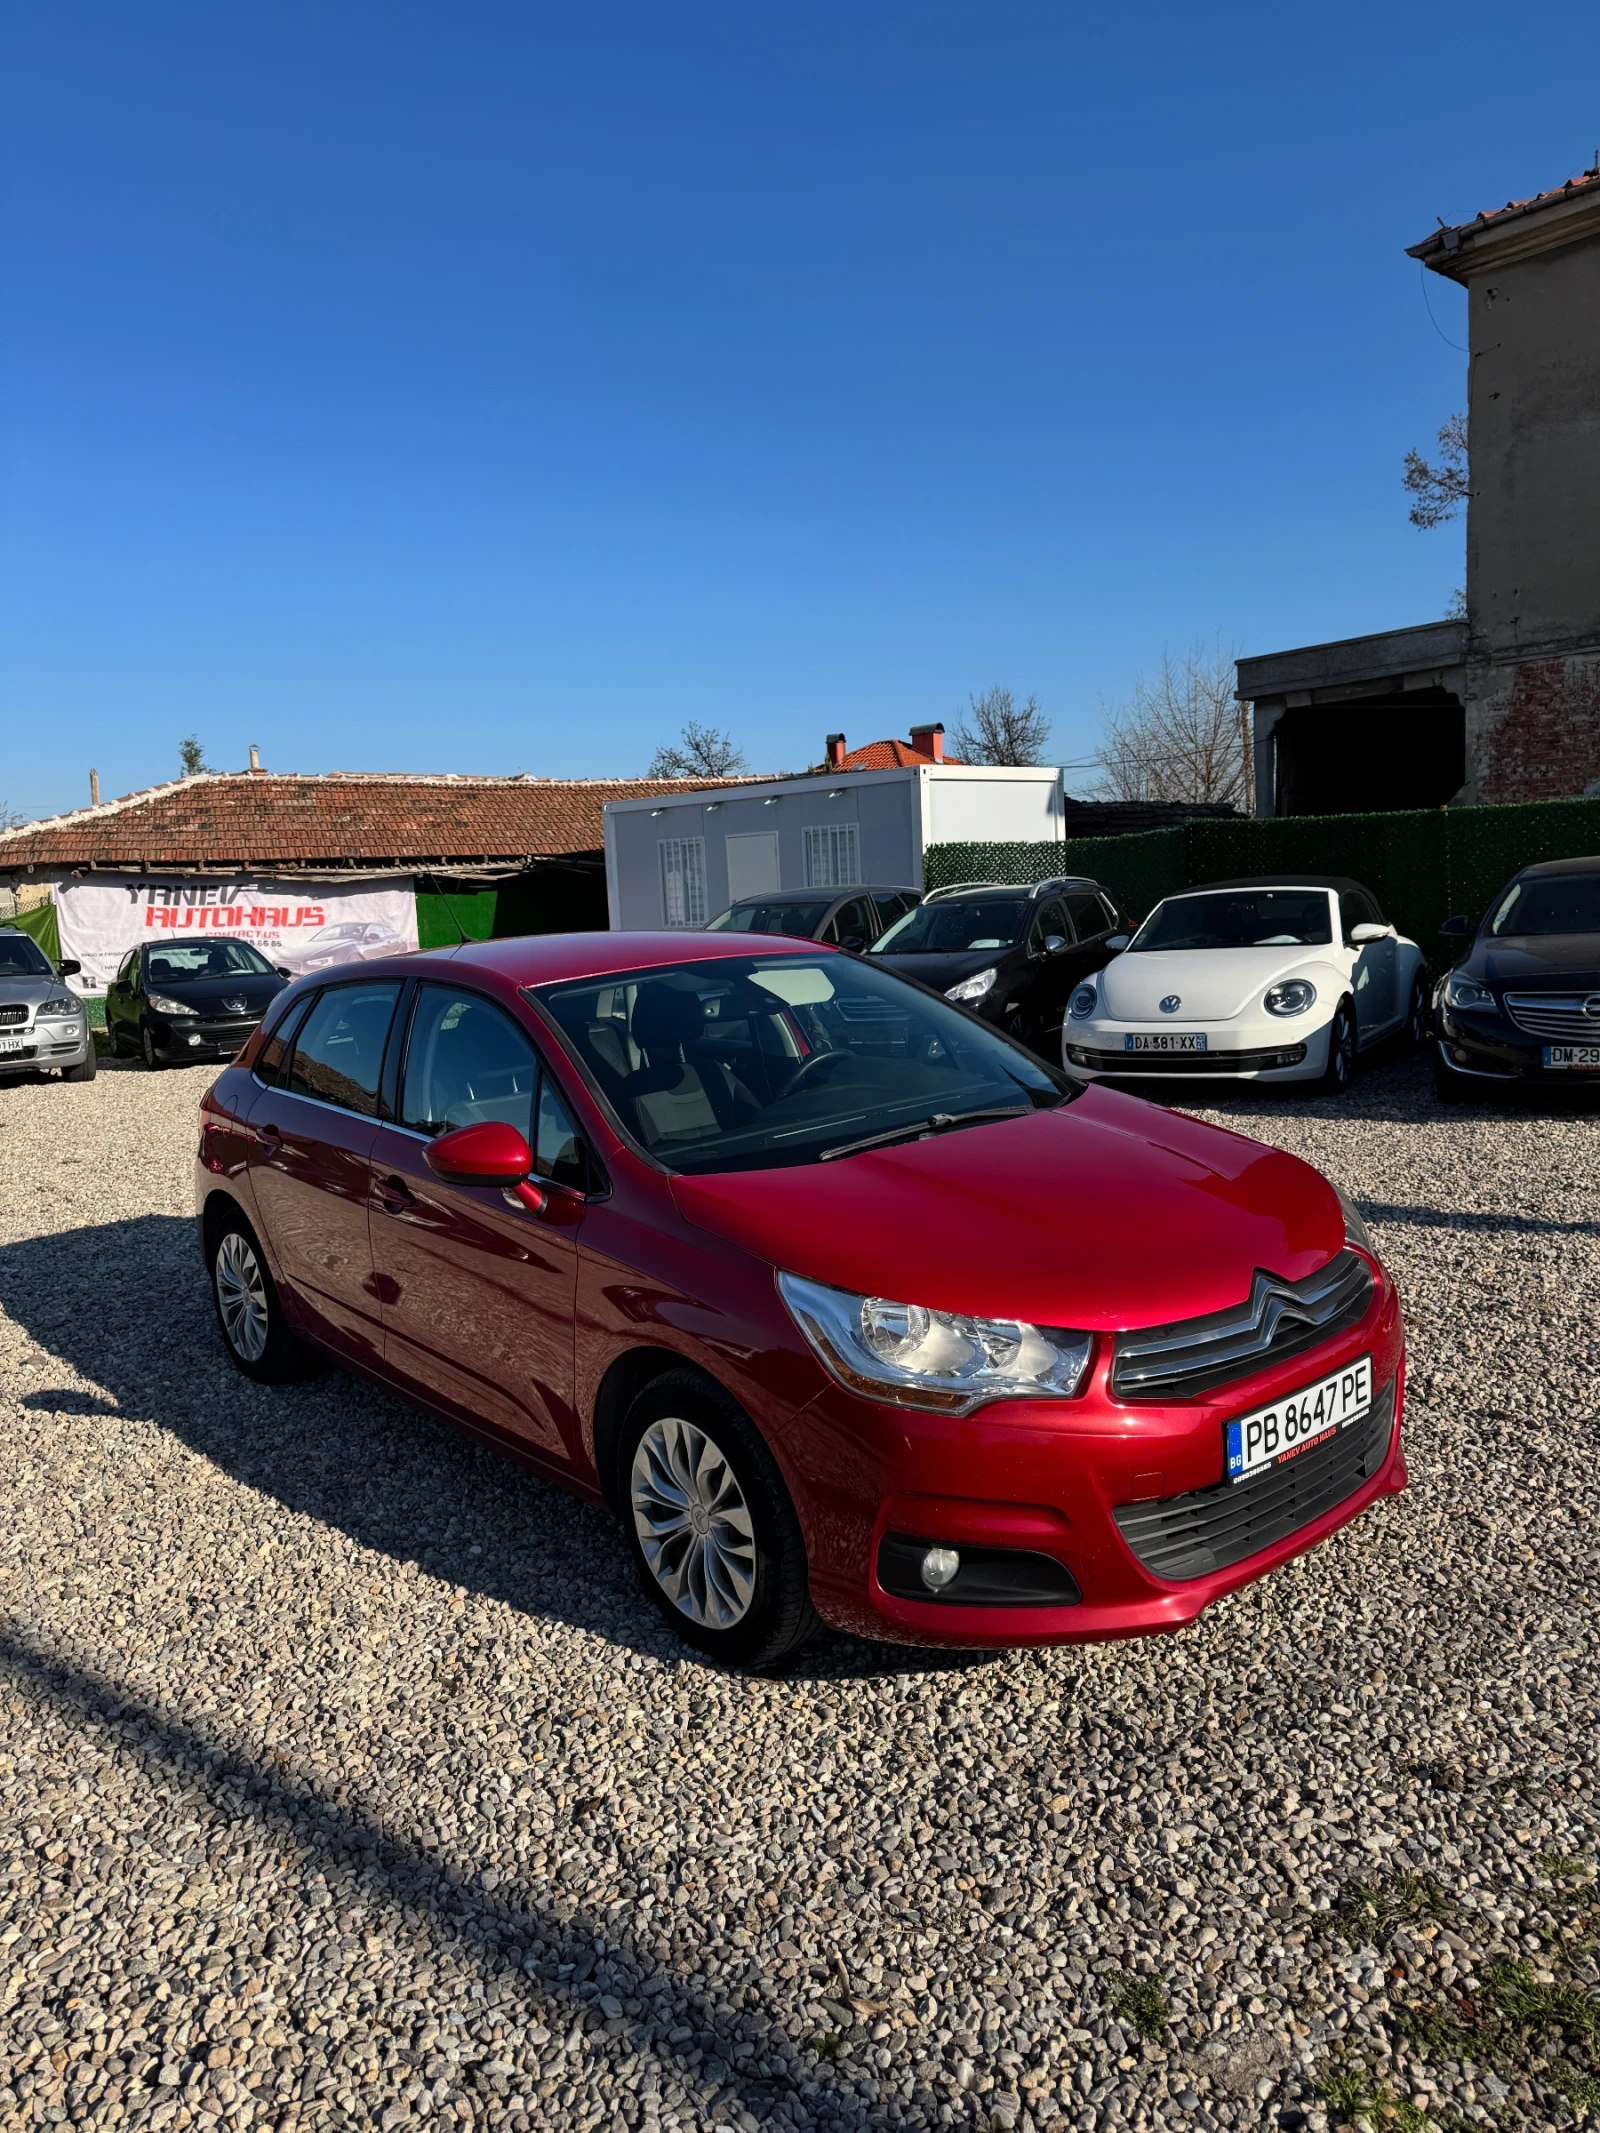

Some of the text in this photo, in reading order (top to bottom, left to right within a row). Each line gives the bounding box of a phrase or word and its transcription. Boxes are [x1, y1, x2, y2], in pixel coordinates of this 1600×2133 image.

[125, 883, 244, 906] YANEV
[145, 906, 326, 928] AUTOHAUS
[205, 930, 262, 938] CONTACT
[1230, 1365, 1368, 1470] BG PB 8647 PE
[1277, 1446, 1300, 1464] YANEV
[1301, 1436, 1320, 1453] AUTO
[1320, 1426, 1338, 1442] HAUS
